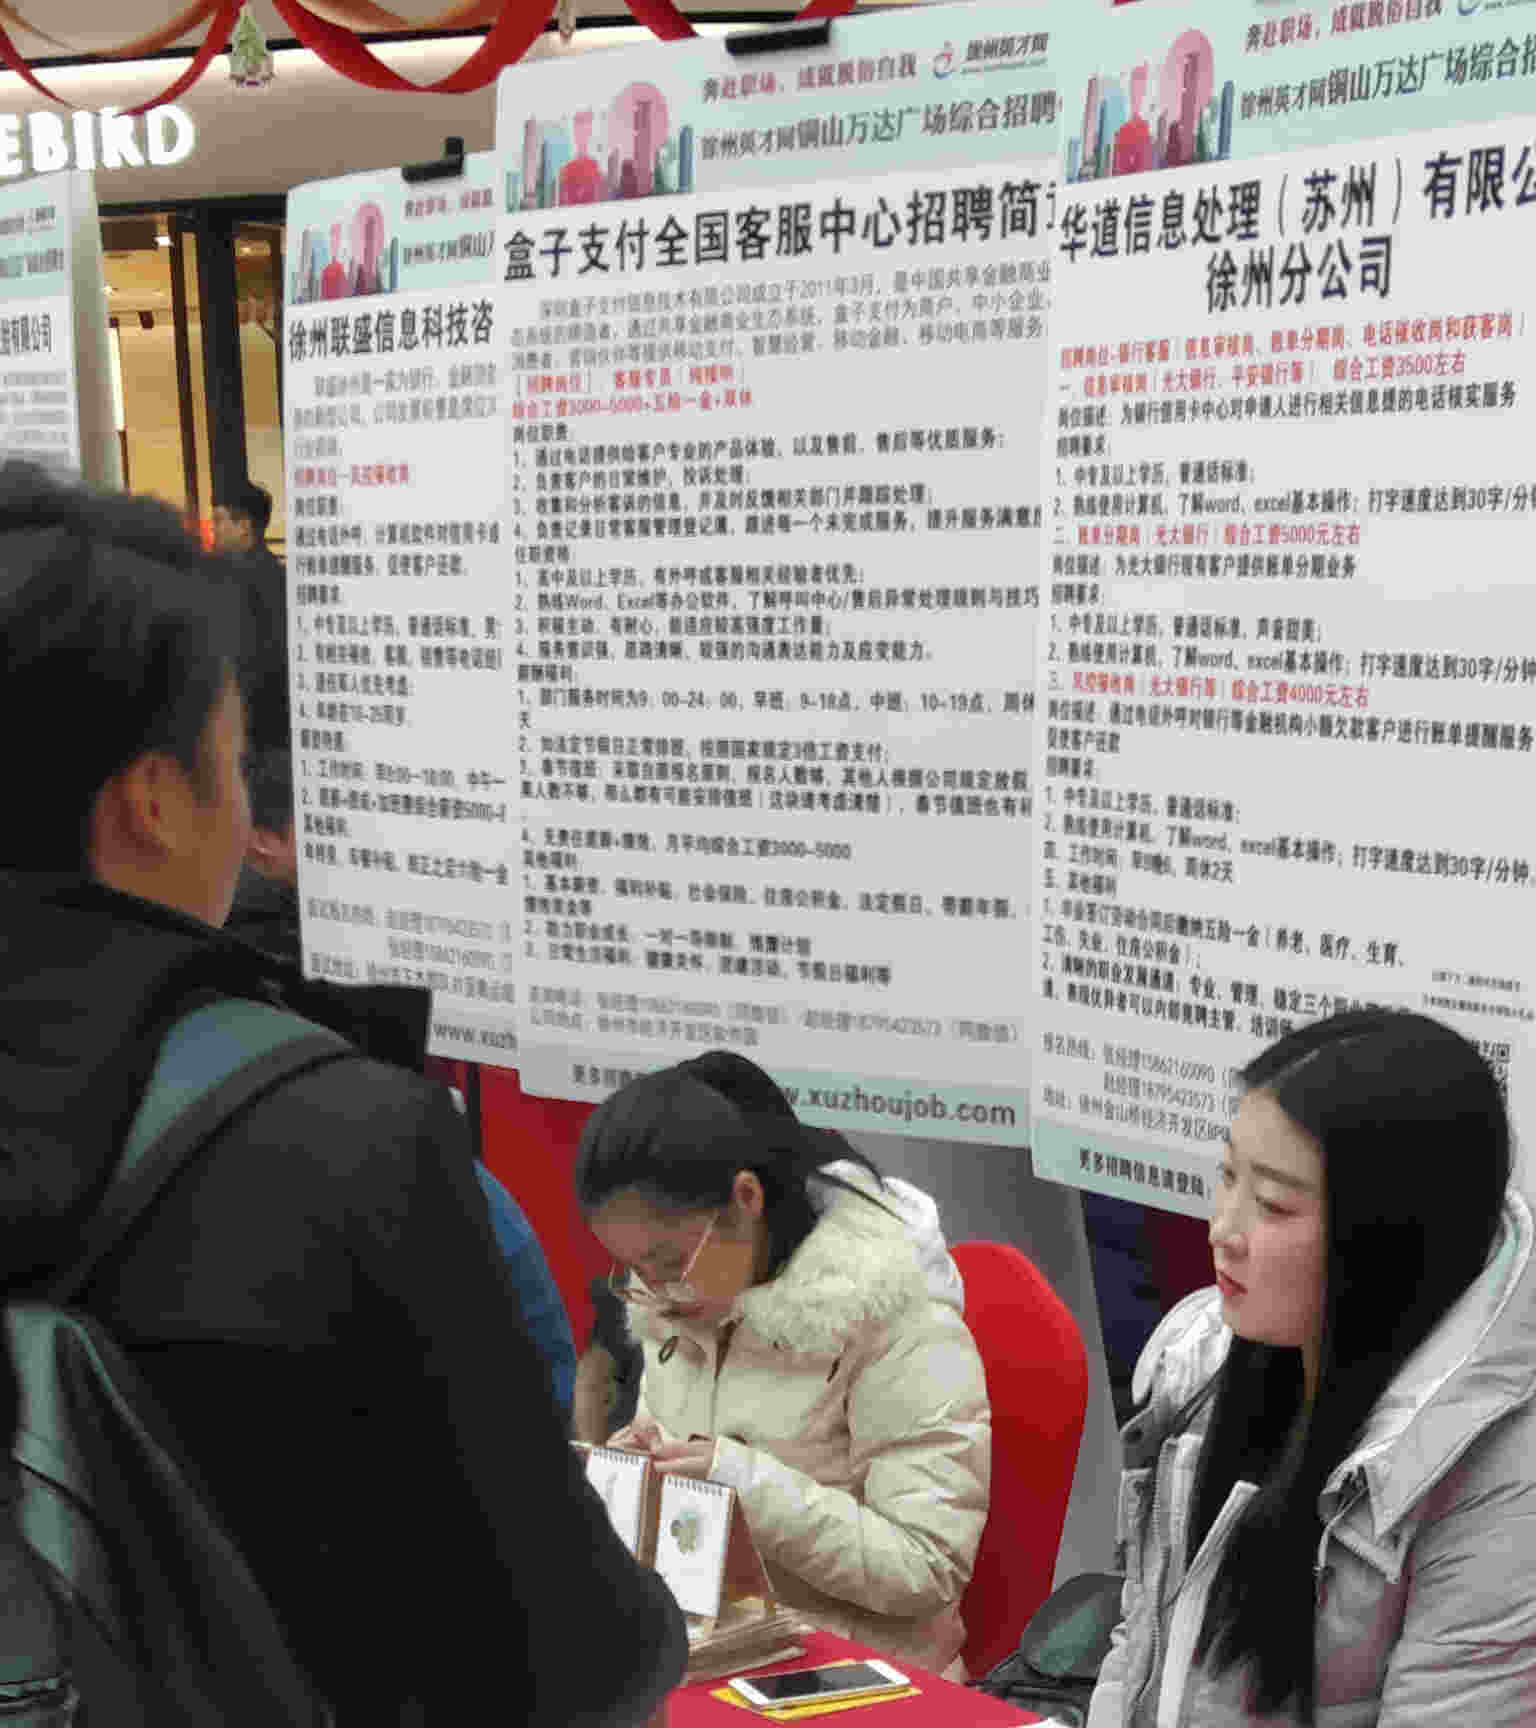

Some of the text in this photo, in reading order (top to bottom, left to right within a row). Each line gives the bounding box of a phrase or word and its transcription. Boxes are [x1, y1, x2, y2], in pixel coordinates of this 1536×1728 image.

[701, 90, 1062, 161] 徐州英才网铜山万达广场综合招聘
[1206, 235, 1393, 314] 徐州分公司
